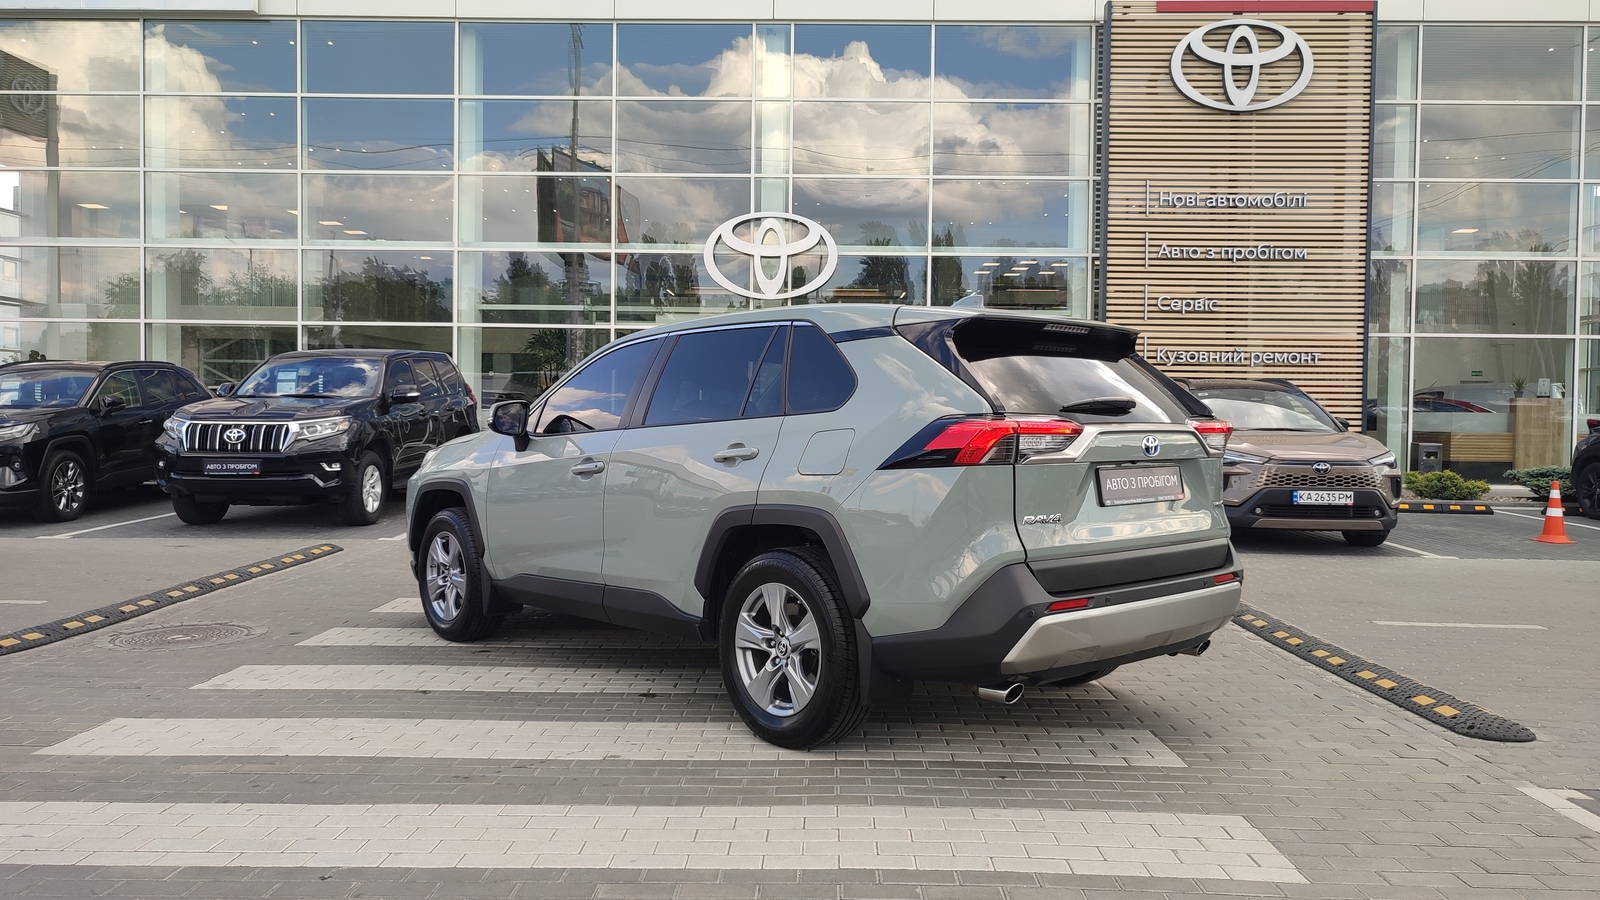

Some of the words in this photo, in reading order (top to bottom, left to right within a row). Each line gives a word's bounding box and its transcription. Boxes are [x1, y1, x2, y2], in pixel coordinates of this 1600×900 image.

[1158, 191, 1200, 207] Нові
[1205, 191, 1308, 208] автомобілі
[1157, 243, 1200, 259] Авто
[1205, 246, 1215, 259] з
[1221, 244, 1308, 263] пробігом
[1157, 295, 1219, 315] Сервіс
[1156, 347, 1245, 366] Кузовний
[1250, 351, 1321, 367] ремонт
[1106, 477, 1129, 491] АВТО
[1137, 475, 1178, 489] ПРОБІГОМ
[1022, 513, 1062, 525] RAV4
